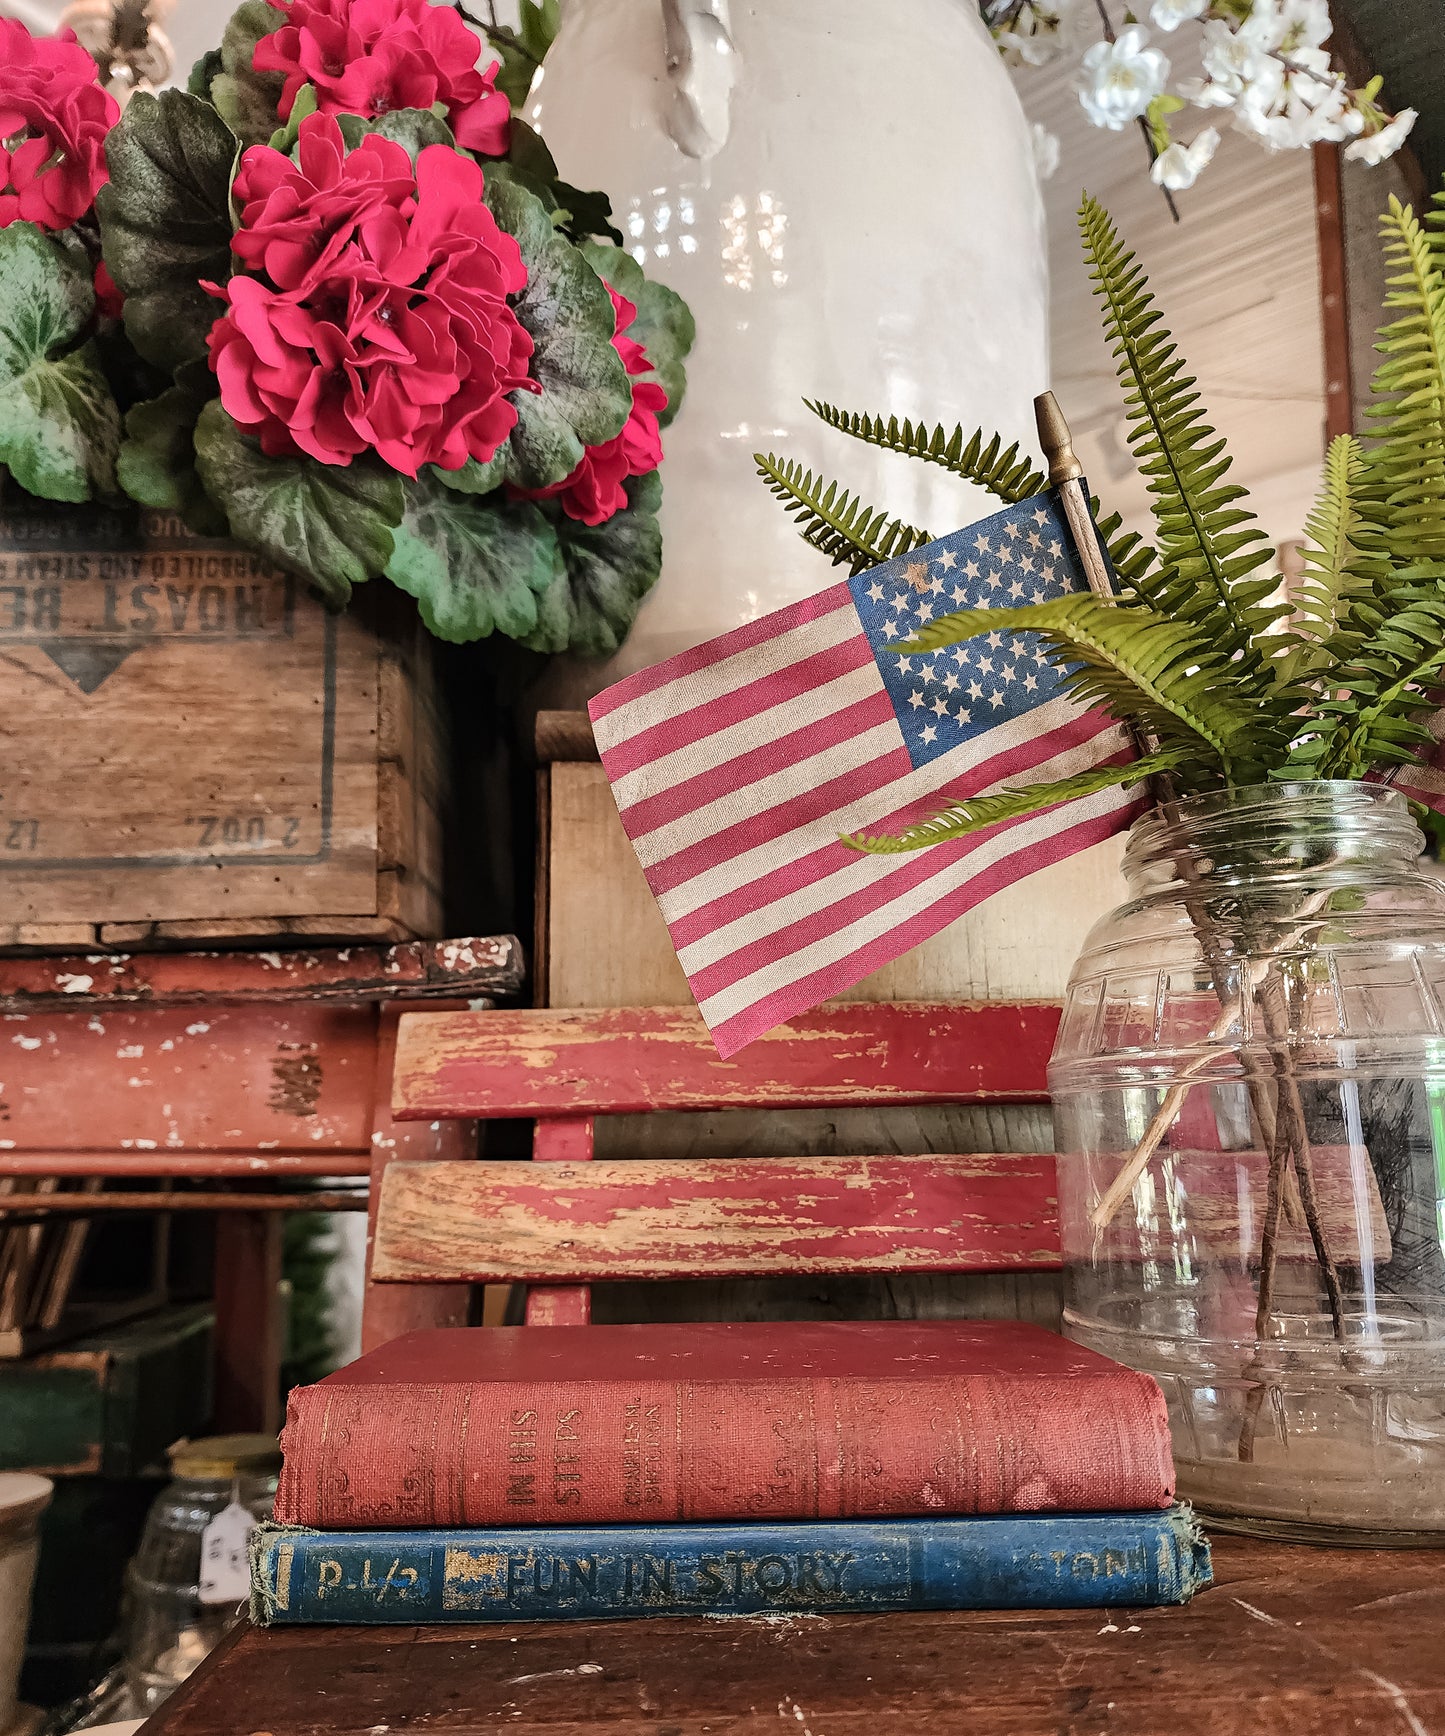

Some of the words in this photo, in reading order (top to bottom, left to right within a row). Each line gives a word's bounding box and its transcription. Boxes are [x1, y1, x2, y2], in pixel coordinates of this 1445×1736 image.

[17, 555, 92, 580] STEAM
[99, 555, 144, 579] AND
[91, 583, 265, 633] ROAST
[281, 816, 301, 848] 2
[509, 1410, 538, 1464] HIS
[553, 1409, 582, 1505] STEPS
[507, 1474, 536, 1504] IN
[507, 1555, 600, 1599] FUN
[625, 1555, 673, 1599] IN
[697, 1551, 855, 1597] STORY
